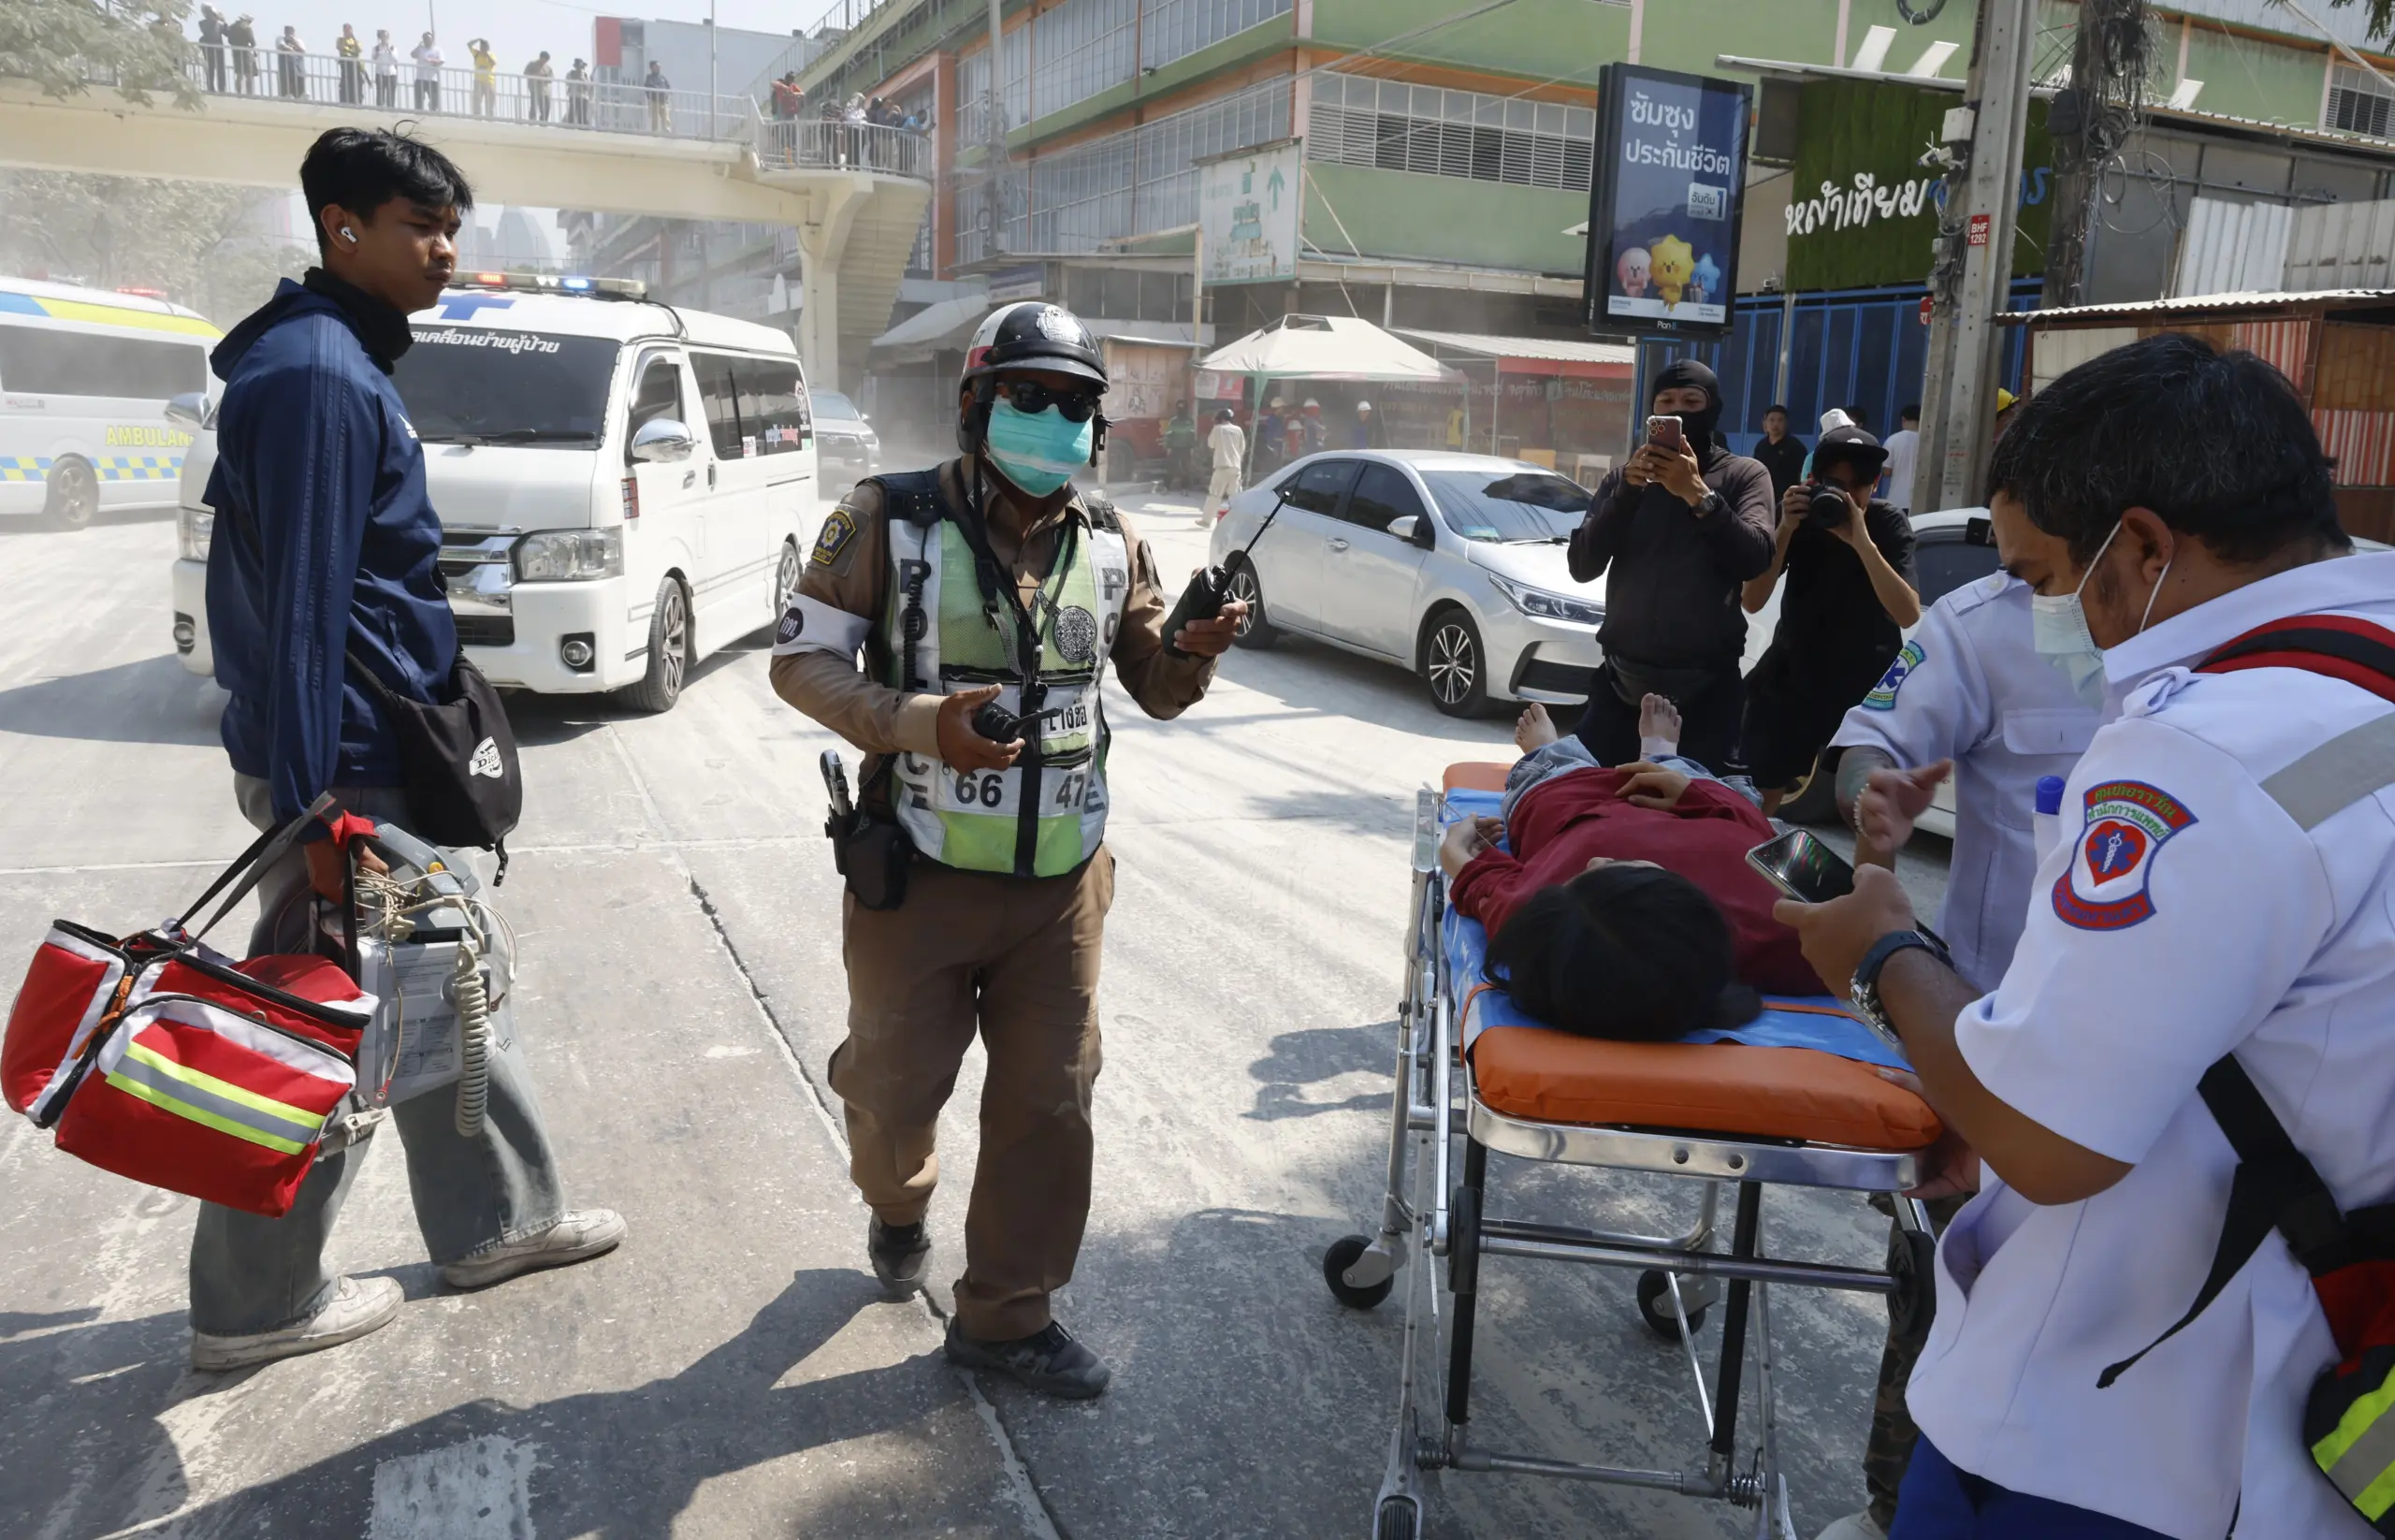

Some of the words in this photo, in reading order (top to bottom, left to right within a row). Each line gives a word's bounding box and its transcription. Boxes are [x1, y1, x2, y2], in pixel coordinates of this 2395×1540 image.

[1630, 91, 1695, 138] ซัมซุง
[1625, 138, 1731, 175] ประกันชีวิต
[1691, 192, 1716, 205] อันดับ
[1970, 233, 1987, 244] 1292
[1971, 222, 1988, 234] BHF
[955, 772, 1003, 808] 66
[1055, 774, 1085, 808] 47
